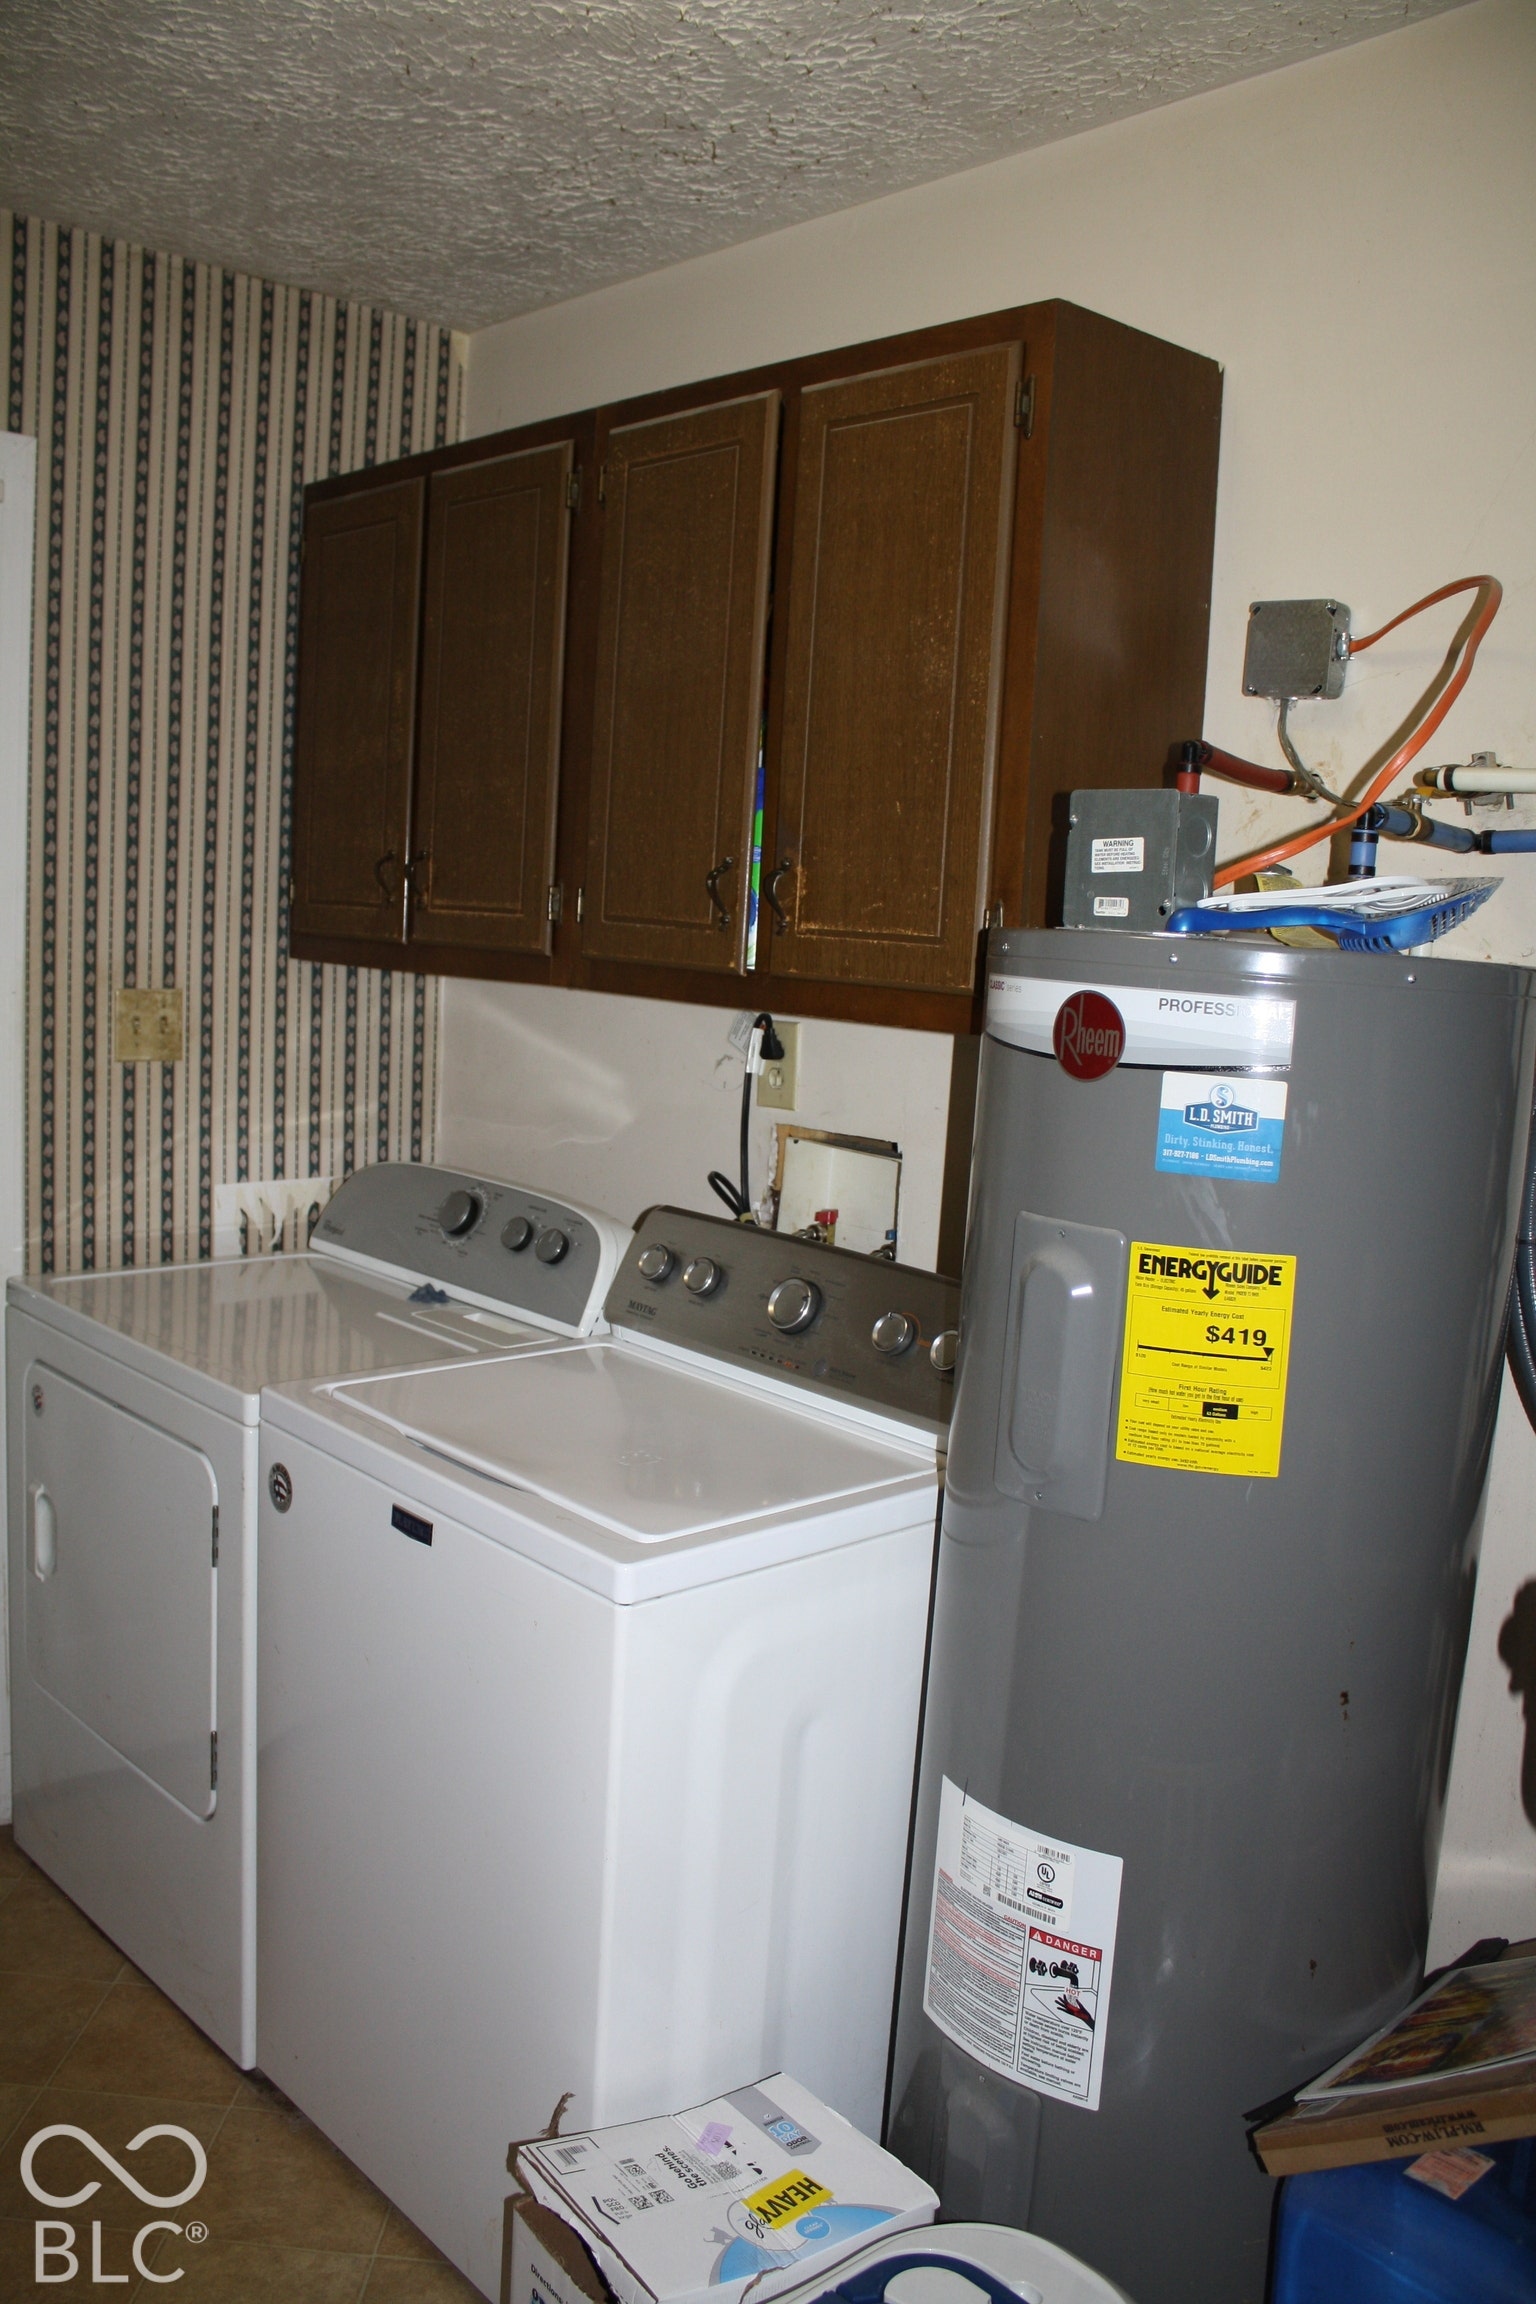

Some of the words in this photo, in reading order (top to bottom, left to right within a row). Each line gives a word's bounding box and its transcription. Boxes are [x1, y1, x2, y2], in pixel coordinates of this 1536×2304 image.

[1060, 994, 1120, 1066] Rheem
[1189, 1107, 1210, 1122] L.D.
[1213, 1109, 1254, 1126] SMITH
[1164, 1134, 1190, 1148] Dirty.
[1193, 1137, 1235, 1153] Stinking.
[1238, 1141, 1274, 1154] Honest.
[1138, 1254, 1282, 1286] ENERGYGUIDE
[1161, 1306, 1188, 1314] Estimated
[1206, 1325, 1267, 1346] $419
[1041, 1866, 1051, 1880] UL
[1045, 1937, 1097, 1958] DANGER
[1066, 1987, 1081, 1996] HOT
[768, 2121, 795, 2138] 10
[655, 2153, 688, 2180] behind
[684, 2178, 698, 2189] Go
[690, 2173, 707, 2187] the
[756, 2177, 823, 2224] HEAVY
